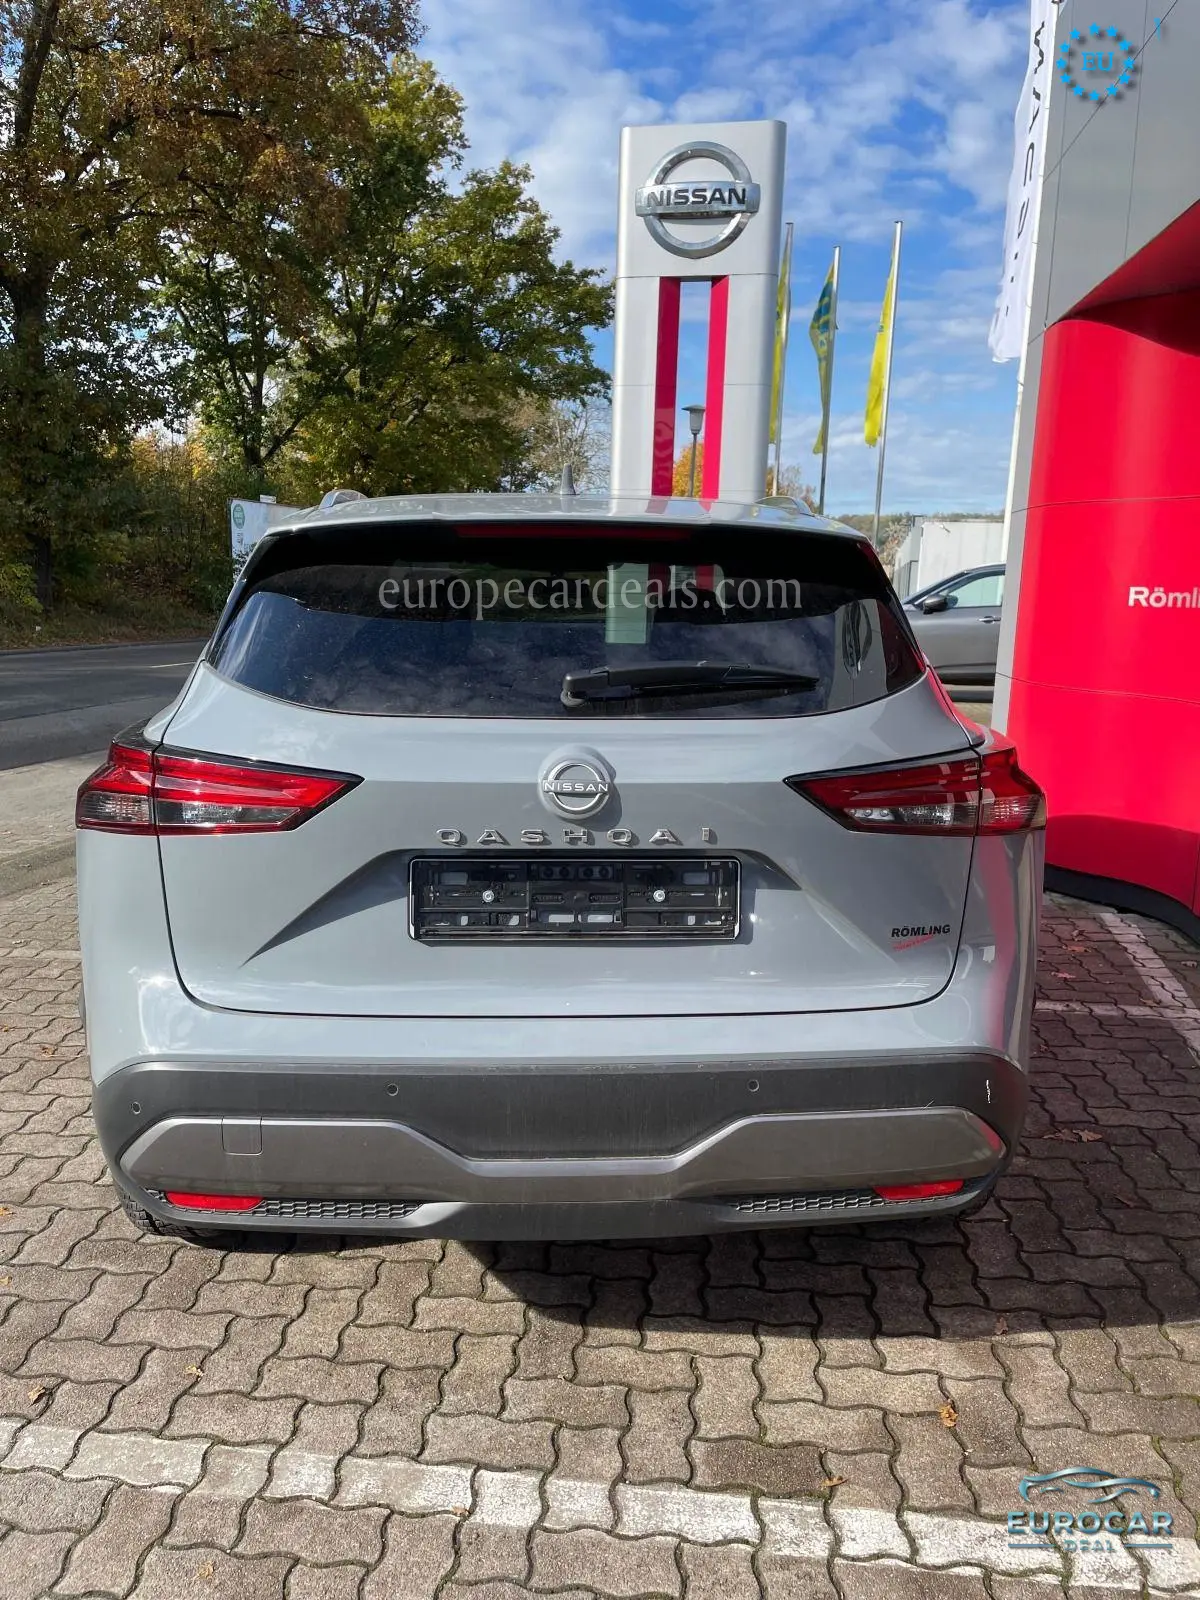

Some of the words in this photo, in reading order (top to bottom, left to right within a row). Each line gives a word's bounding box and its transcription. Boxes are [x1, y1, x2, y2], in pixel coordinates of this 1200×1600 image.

[646, 187, 746, 207] NISSAN
[543, 781, 609, 793] NISSAN
[436, 827, 712, 846] QASHQAI
[891, 924, 951, 938] RÖMLING
